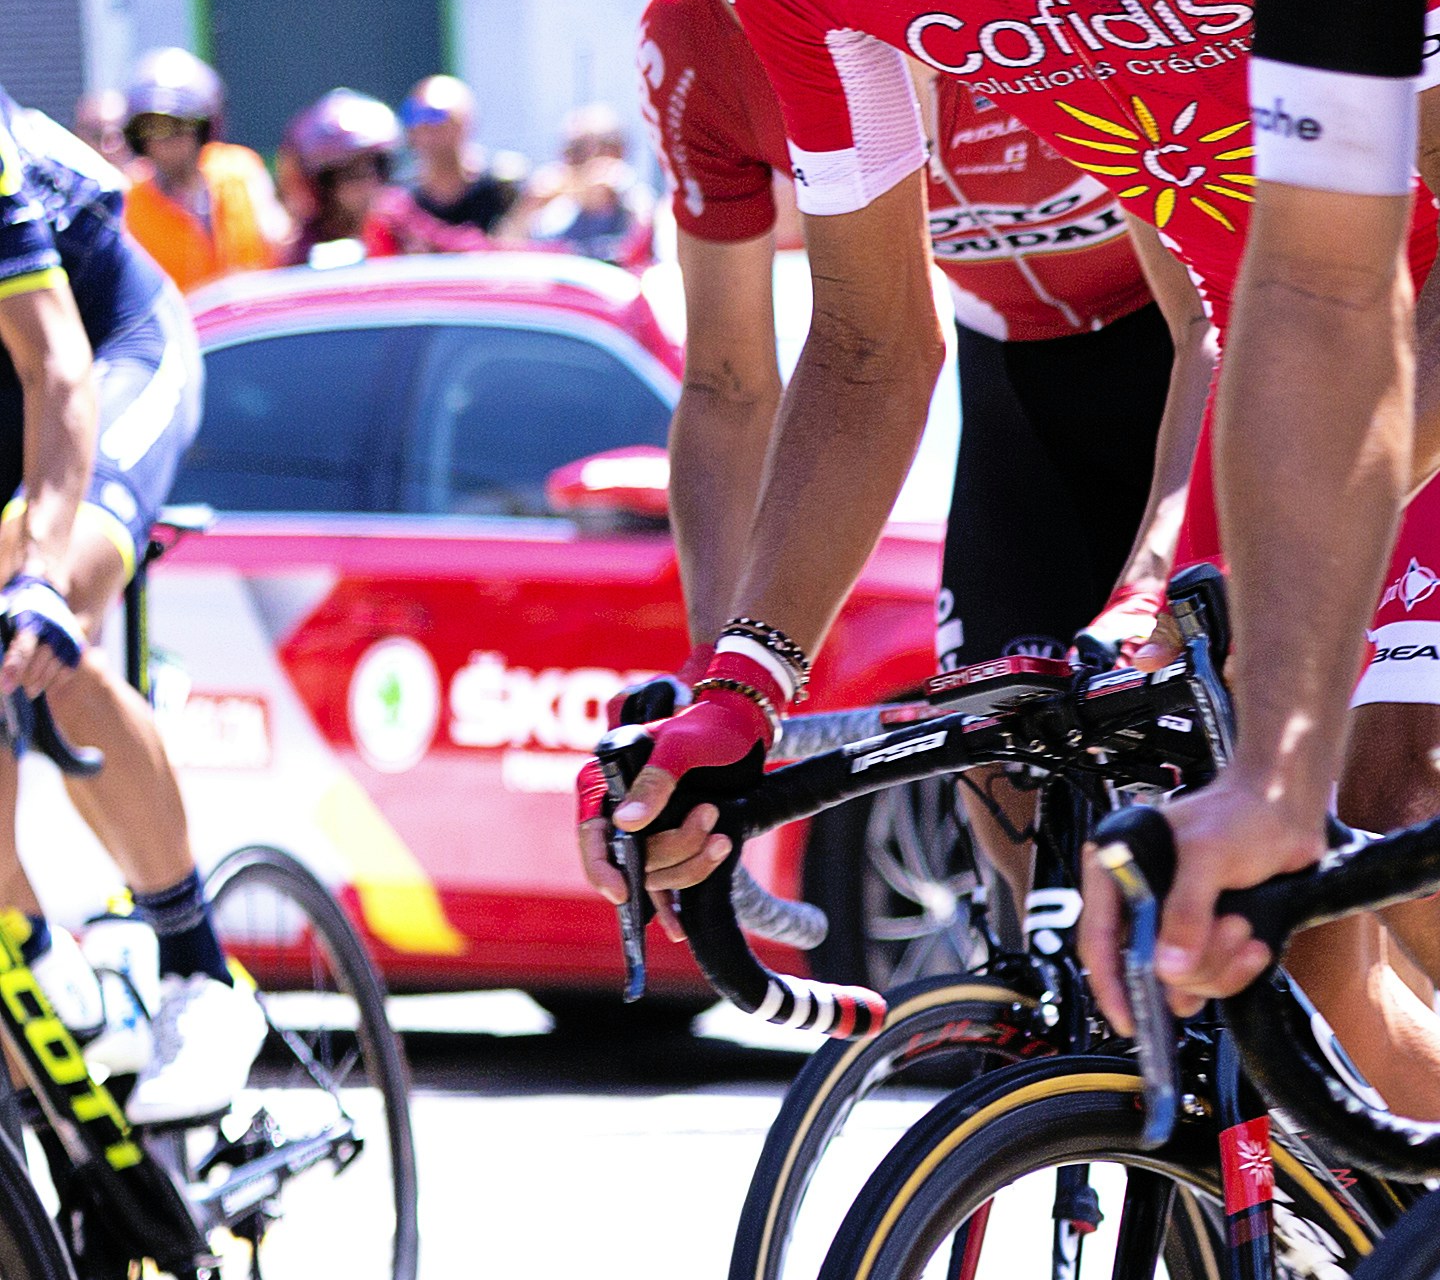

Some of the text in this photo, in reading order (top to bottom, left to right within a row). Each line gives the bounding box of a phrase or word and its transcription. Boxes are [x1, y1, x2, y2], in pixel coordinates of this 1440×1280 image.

[1127, 33, 1254, 78] crédit
[931, 192, 1081, 234] OTTO
[450, 650, 612, 750] ŠKO
[0, 948, 142, 1170] COT
